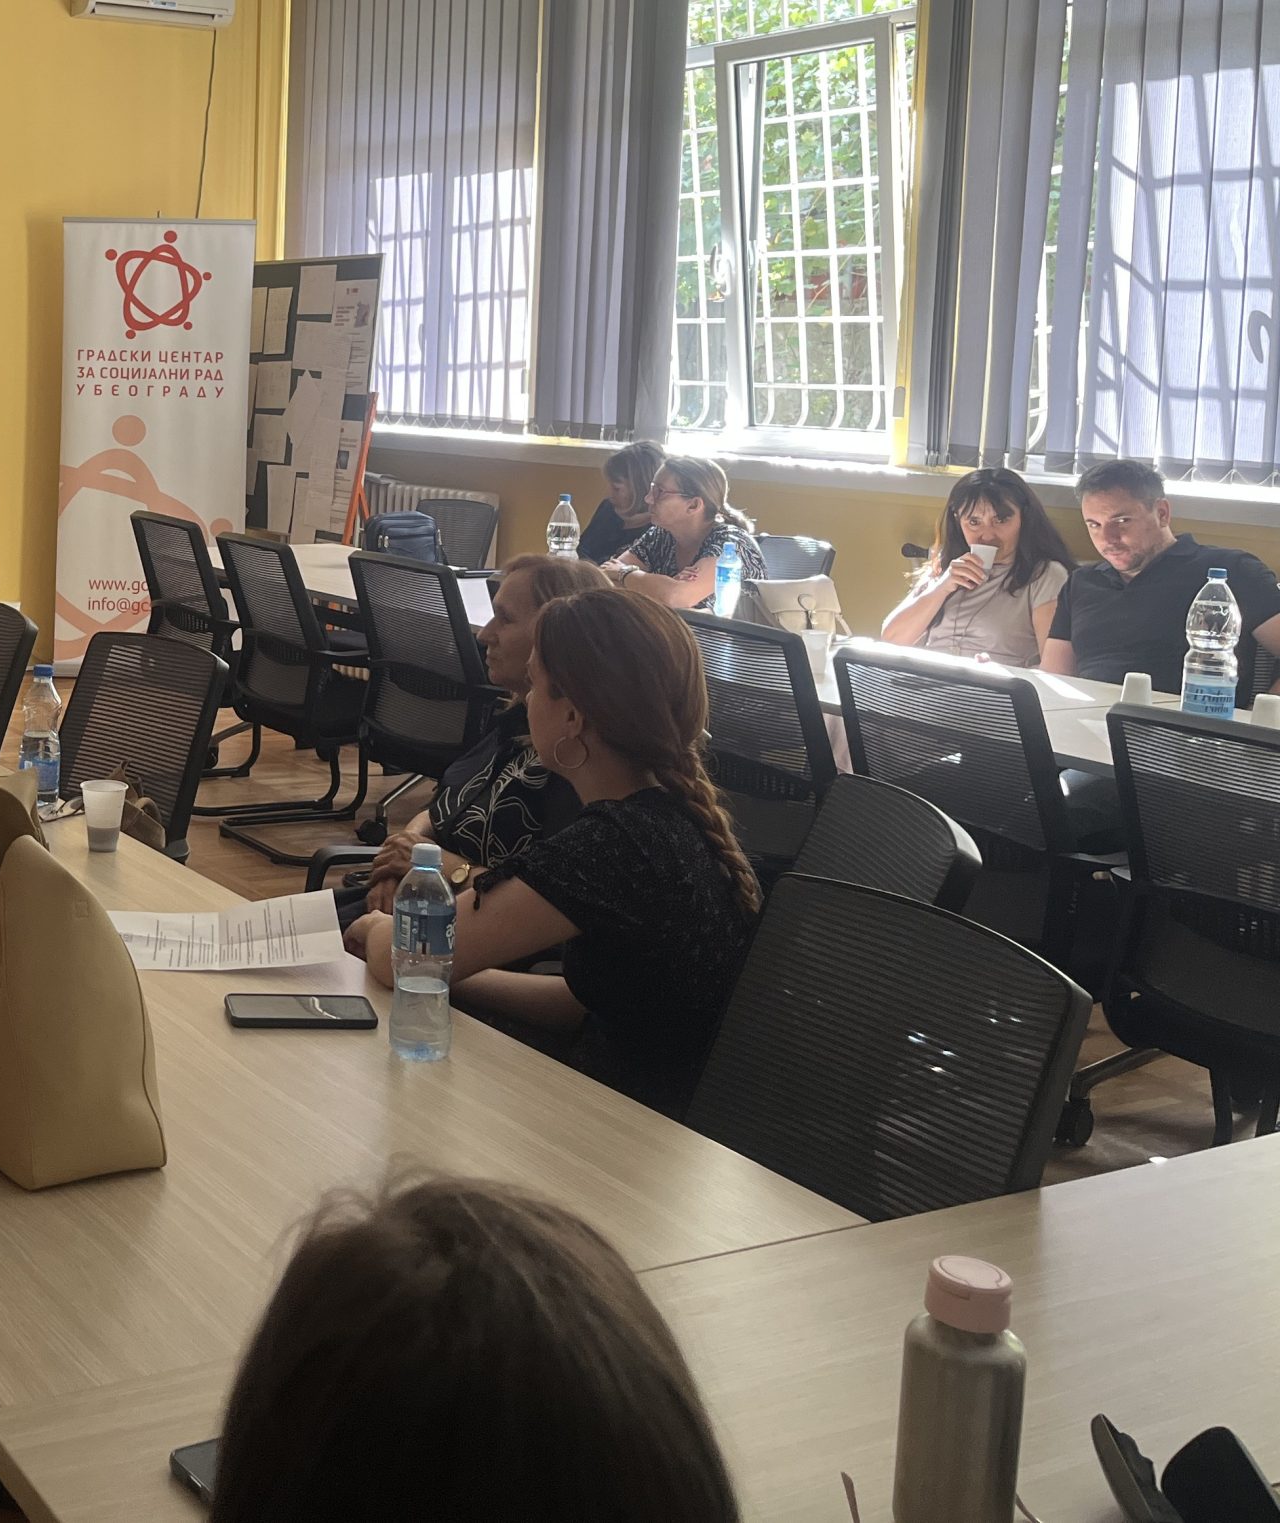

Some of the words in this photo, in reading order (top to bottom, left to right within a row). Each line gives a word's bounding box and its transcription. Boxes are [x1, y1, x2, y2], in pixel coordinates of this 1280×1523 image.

[77, 349, 151, 362] ГРАДСКИ
[158, 351, 224, 363] ЦЕНТАР
[77, 366, 95, 378] ЗА
[100, 367, 190, 380] СОЦИЈАЛНИ
[195, 369, 224, 380] РАД
[89, 579, 149, 594] www.gc
[88, 597, 151, 615] info@gc
